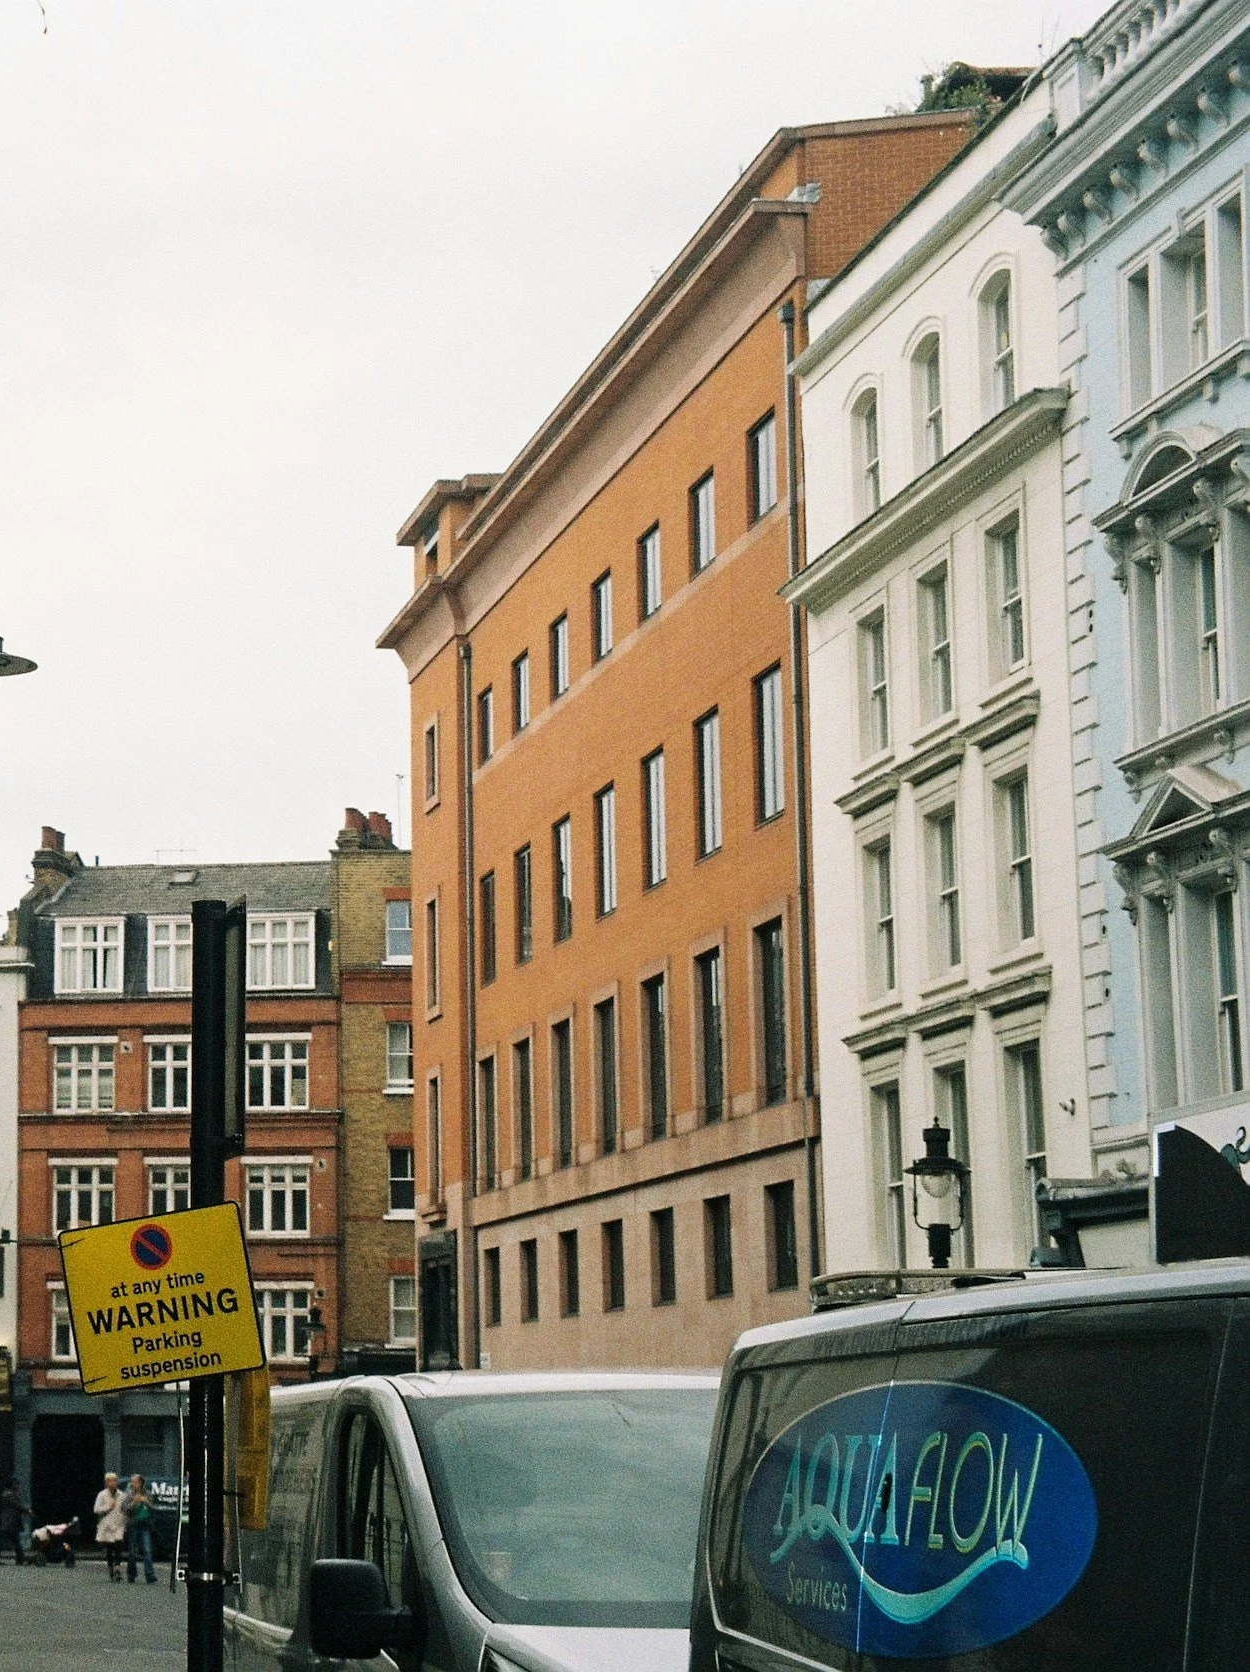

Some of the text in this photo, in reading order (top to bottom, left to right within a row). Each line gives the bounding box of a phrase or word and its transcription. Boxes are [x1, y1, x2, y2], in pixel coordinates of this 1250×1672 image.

[111, 1272, 205, 1299] at any time
[87, 1288, 239, 1335] WARNING
[132, 1331, 203, 1354] Parking
[120, 1352, 222, 1380] suspension
[786, 1561, 848, 1613] Services
